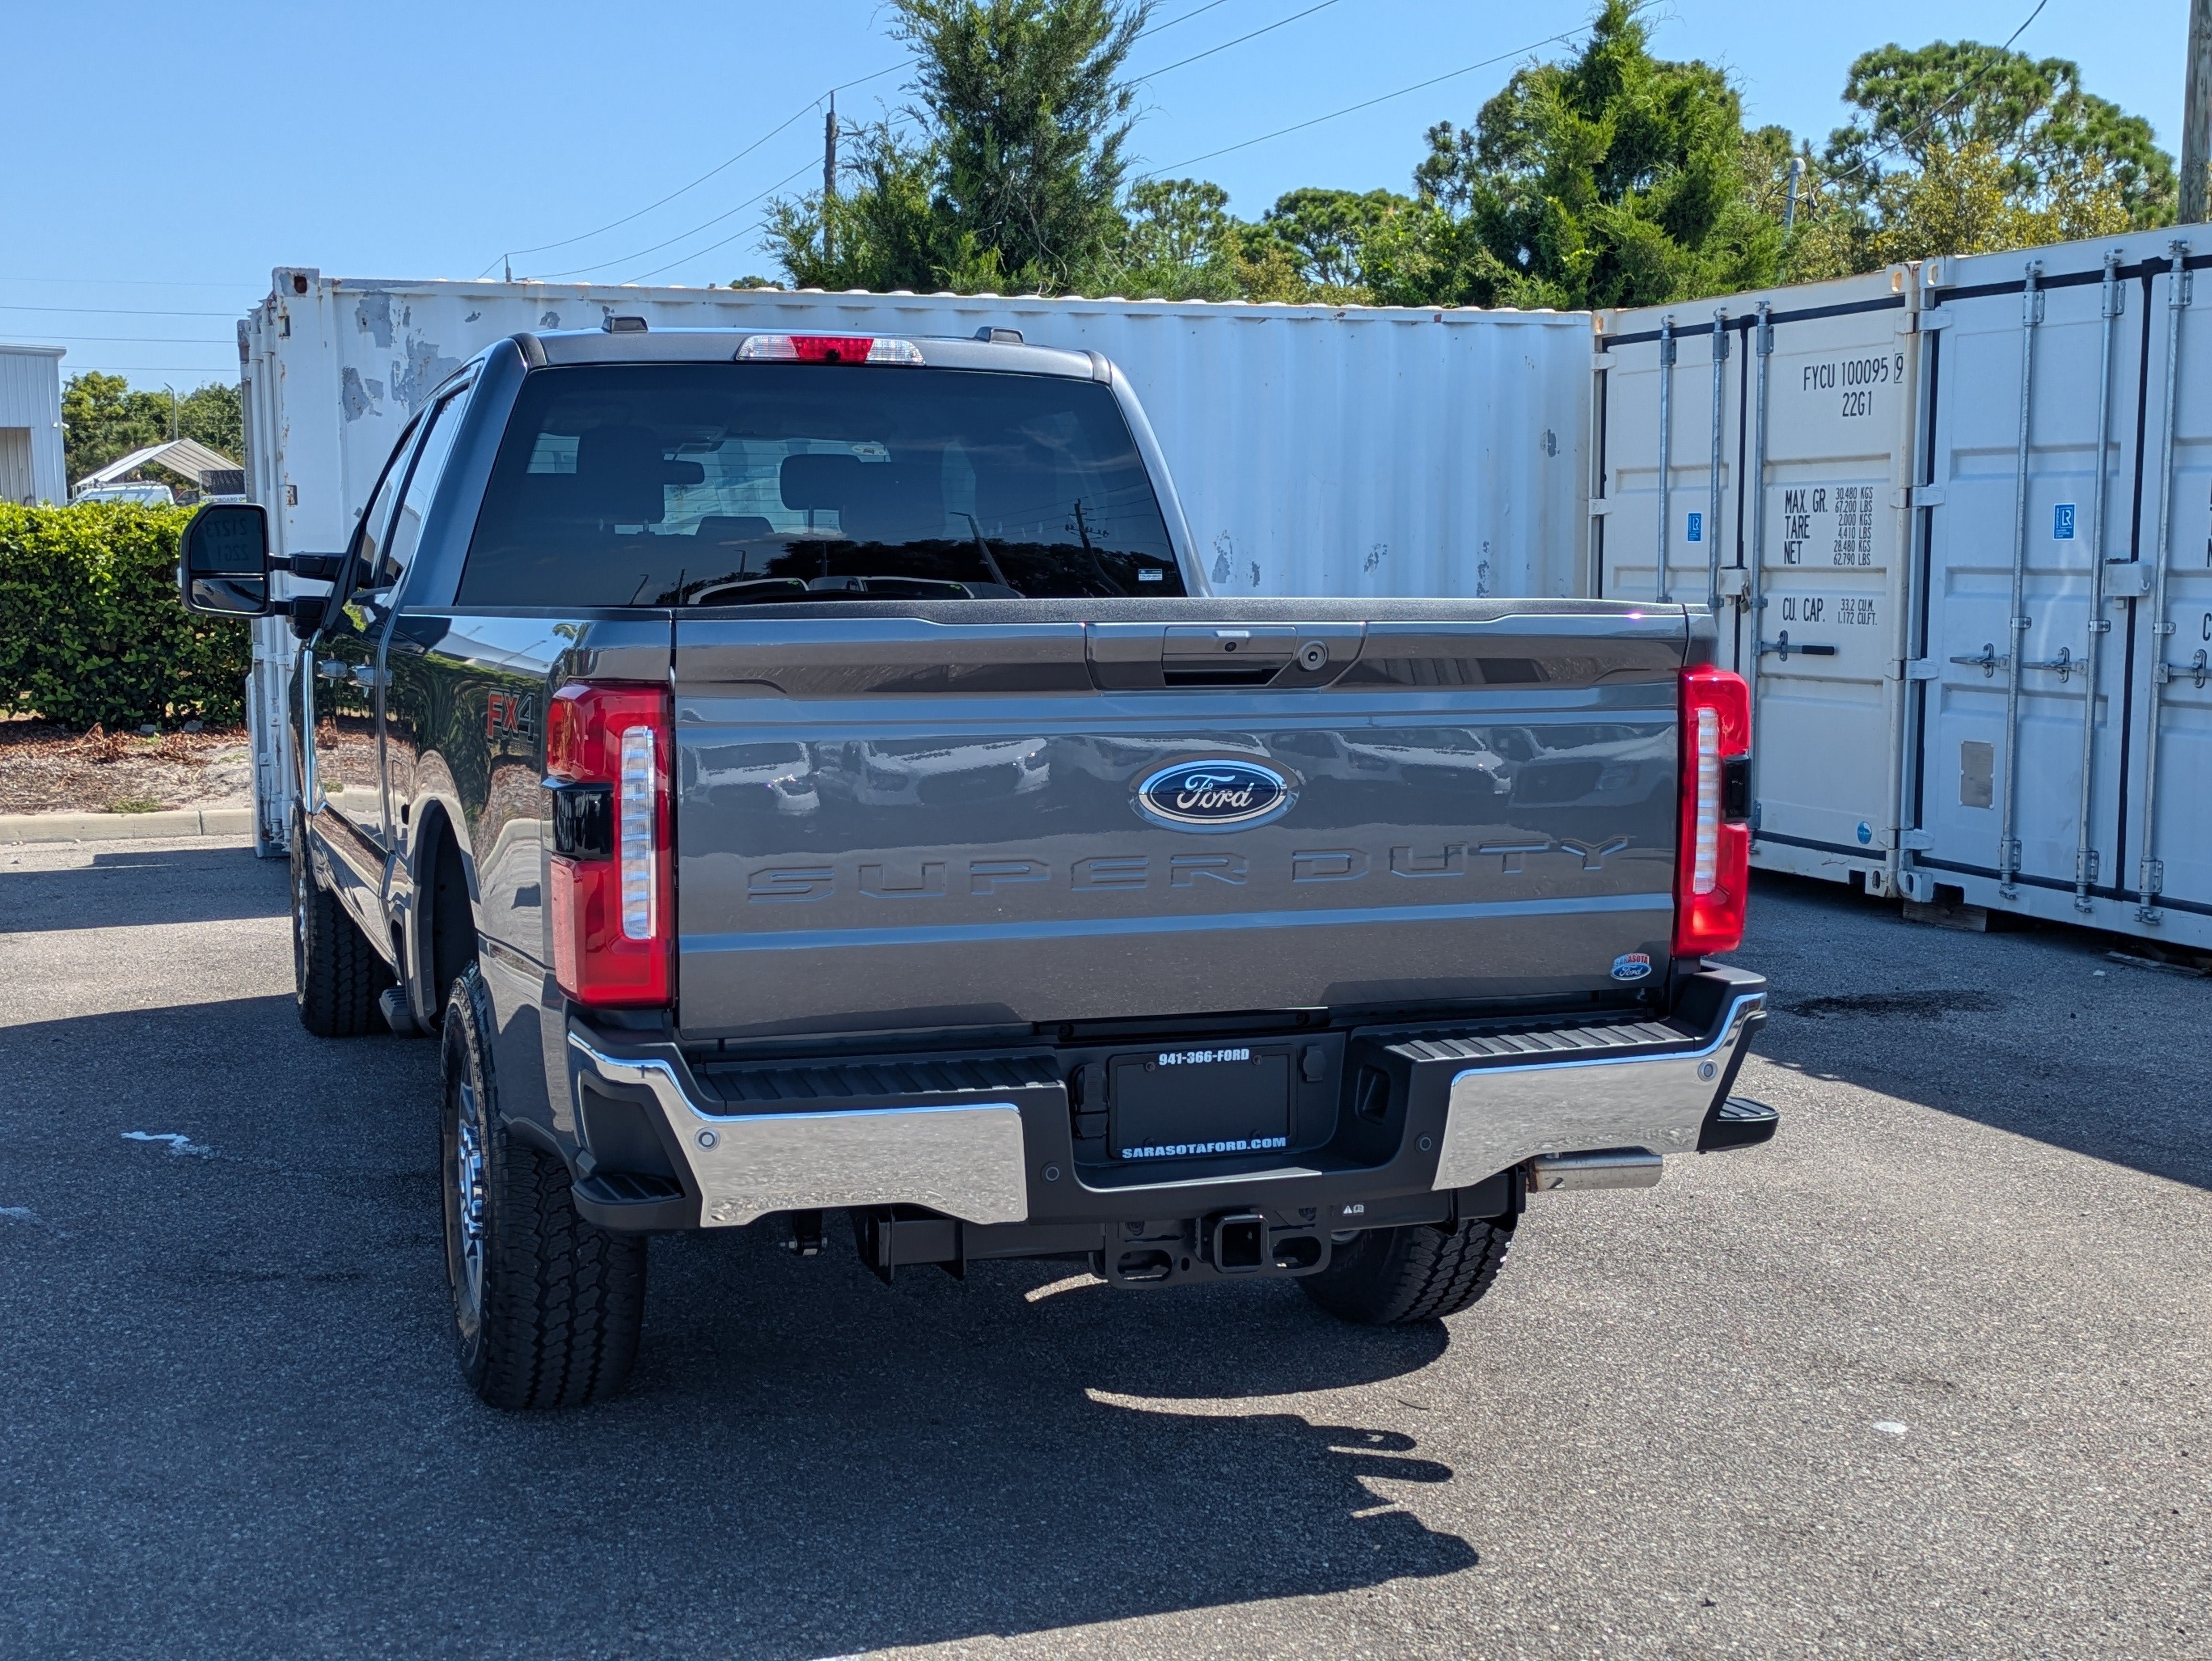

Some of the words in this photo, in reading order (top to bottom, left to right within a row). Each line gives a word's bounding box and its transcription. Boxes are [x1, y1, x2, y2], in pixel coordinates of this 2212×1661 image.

[1803, 363, 1835, 391] FYCU
[1842, 357, 1889, 386] 100095
[1895, 355, 1904, 381] 9
[1842, 390, 1872, 417] 22G1
[1785, 489, 1807, 514] MAX.
[1813, 488, 1828, 513] GR.
[1836, 487, 1858, 500] 30.480
[1860, 487, 1873, 499] KGS
[1835, 500, 1857, 513] 67.200
[1860, 500, 1872, 513] LBS
[1838, 513, 1856, 526] 2.000
[1859, 513, 1872, 526] KGS
[2062, 509, 2071, 526] LR
[1785, 515, 1810, 539] TARE
[1838, 527, 1856, 539] 4.410
[1859, 527, 1871, 539] LBS
[1784, 541, 1803, 564] NET
[1834, 540, 1856, 553] 28.480
[1858, 540, 1871, 553] KGS
[1833, 553, 1855, 565] 62.790
[1858, 553, 1871, 565] LBS
[1782, 598, 1797, 621] CU.
[1803, 598, 1825, 622] CAP.
[1841, 598, 1855, 612] 33.2
[1838, 611, 1854, 624] 1.172
[487, 687, 535, 744] FX4
[1176, 774, 1255, 809] Ford
[748, 852, 1248, 903] SUPER
[1292, 835, 1628, 882] DUTY
[1614, 954, 1648, 965] SARASOTA
[1619, 965, 1643, 976] Ford
[1158, 1048, 1250, 1065] 941-366-FORD
[1122, 1137, 1286, 1159] SARASOTAFORD.COM
